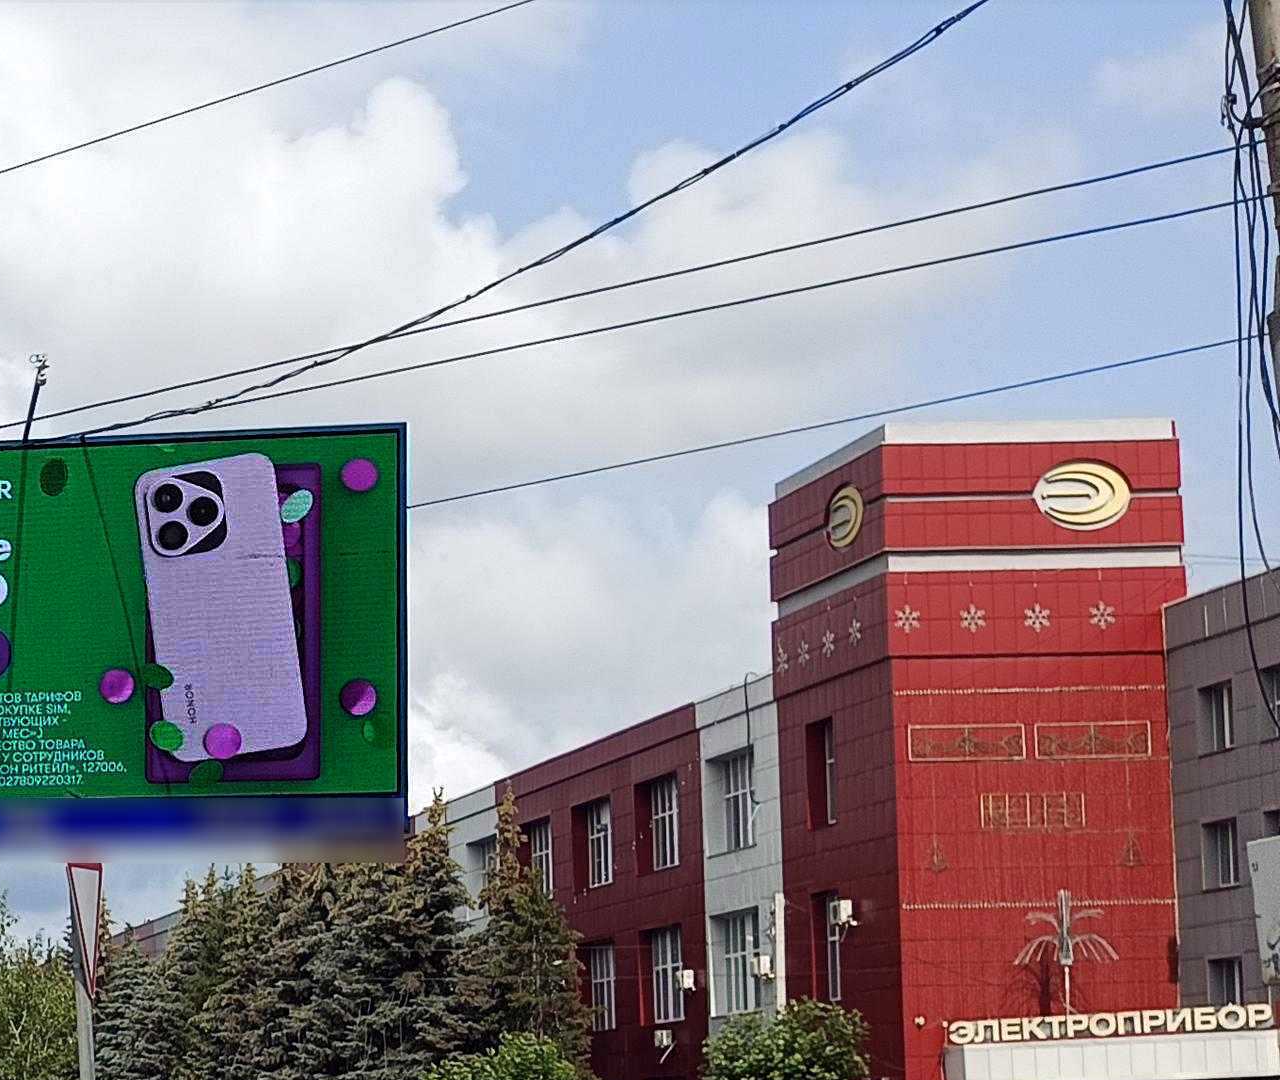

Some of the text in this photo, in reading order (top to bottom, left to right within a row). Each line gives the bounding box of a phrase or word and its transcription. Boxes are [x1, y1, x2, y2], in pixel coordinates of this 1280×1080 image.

[25, 691, 81, 702] ТАРИФОВ
[184, 683, 197, 724] HONOR
[38, 738, 86, 750] ТОВАРА
[2, 752, 10, 763] У
[13, 749, 105, 763] СОТРУДНИКОВ
[948, 1003, 1273, 1045] ЭЛЕКТРОПРИБОР
